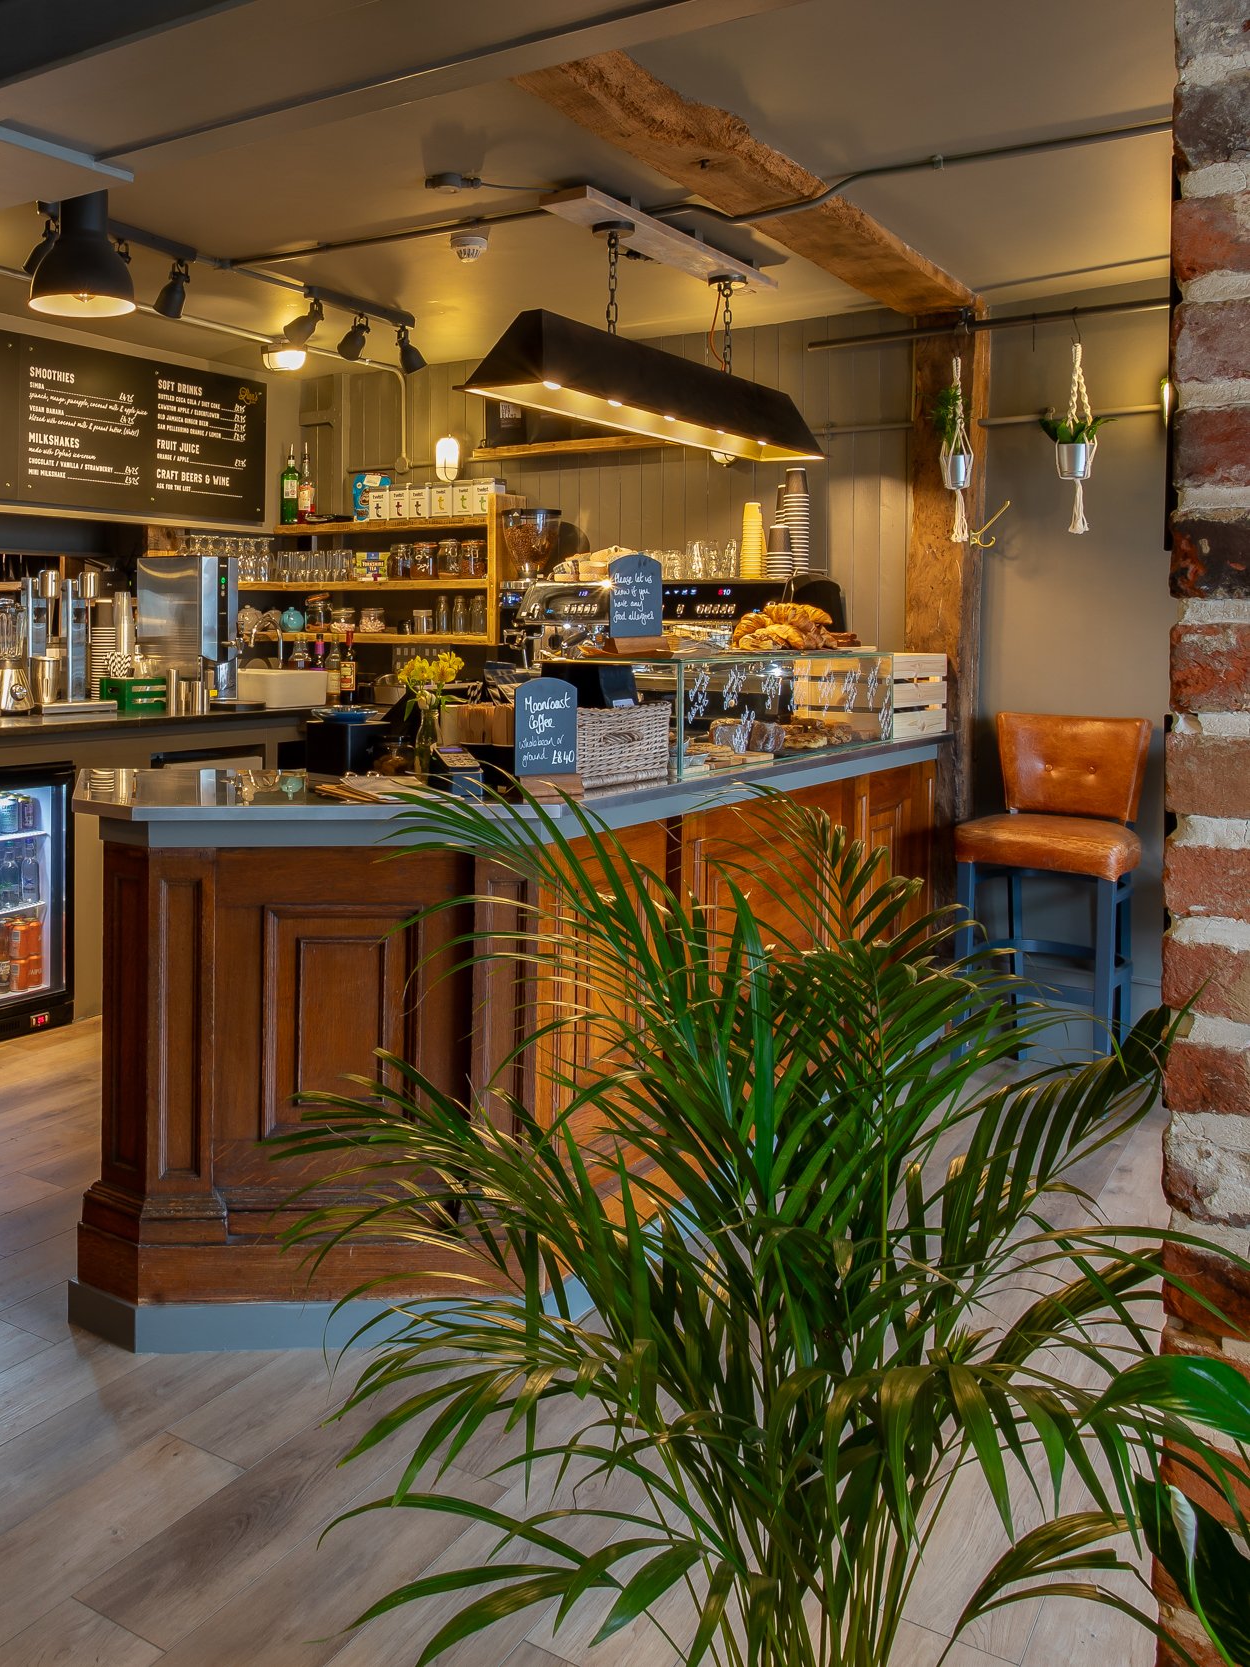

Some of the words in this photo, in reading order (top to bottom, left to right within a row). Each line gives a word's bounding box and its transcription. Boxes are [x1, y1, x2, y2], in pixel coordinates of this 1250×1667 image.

[30, 366, 75, 384] SMOOTHIES
[30, 382, 44, 390] SIMBA
[158, 379, 175, 391] SOFT
[178, 383, 202, 396] DRINKS
[30, 405, 45, 413] VEGAN
[46, 407, 64, 416] BANANA
[177, 406, 190, 414] APPLE
[211, 402, 220, 410] COKE
[29, 432, 80, 448] MILKSHAKES
[157, 439, 177, 451] FRUIT
[179, 443, 200, 454] JUICE
[157, 453, 172, 461] ORANGE
[29, 457, 54, 466] CHOCOLATE
[60, 461, 79, 469] VANILLA
[84, 464, 113, 473] STRAWBERRY
[40, 470, 66, 479] MILKSHAKE
[157, 469, 178, 480] CRAFT
[181, 472, 203, 483] BEERS
[205, 474, 210, 484] &
[213, 475, 230, 486] WINE
[615, 572, 633, 585] Please
[635, 572, 644, 583] let
[614, 586, 630, 596] know
[631, 586, 637, 597] if
[639, 588, 650, 601] you
[614, 599, 628, 608] have
[630, 600, 644, 612] any
[613, 610, 627, 624] food
[524, 692, 571, 713] Moonroast
[529, 714, 555, 735] Coffee
[557, 734, 564, 744] or
[522, 747, 549, 768] ground
